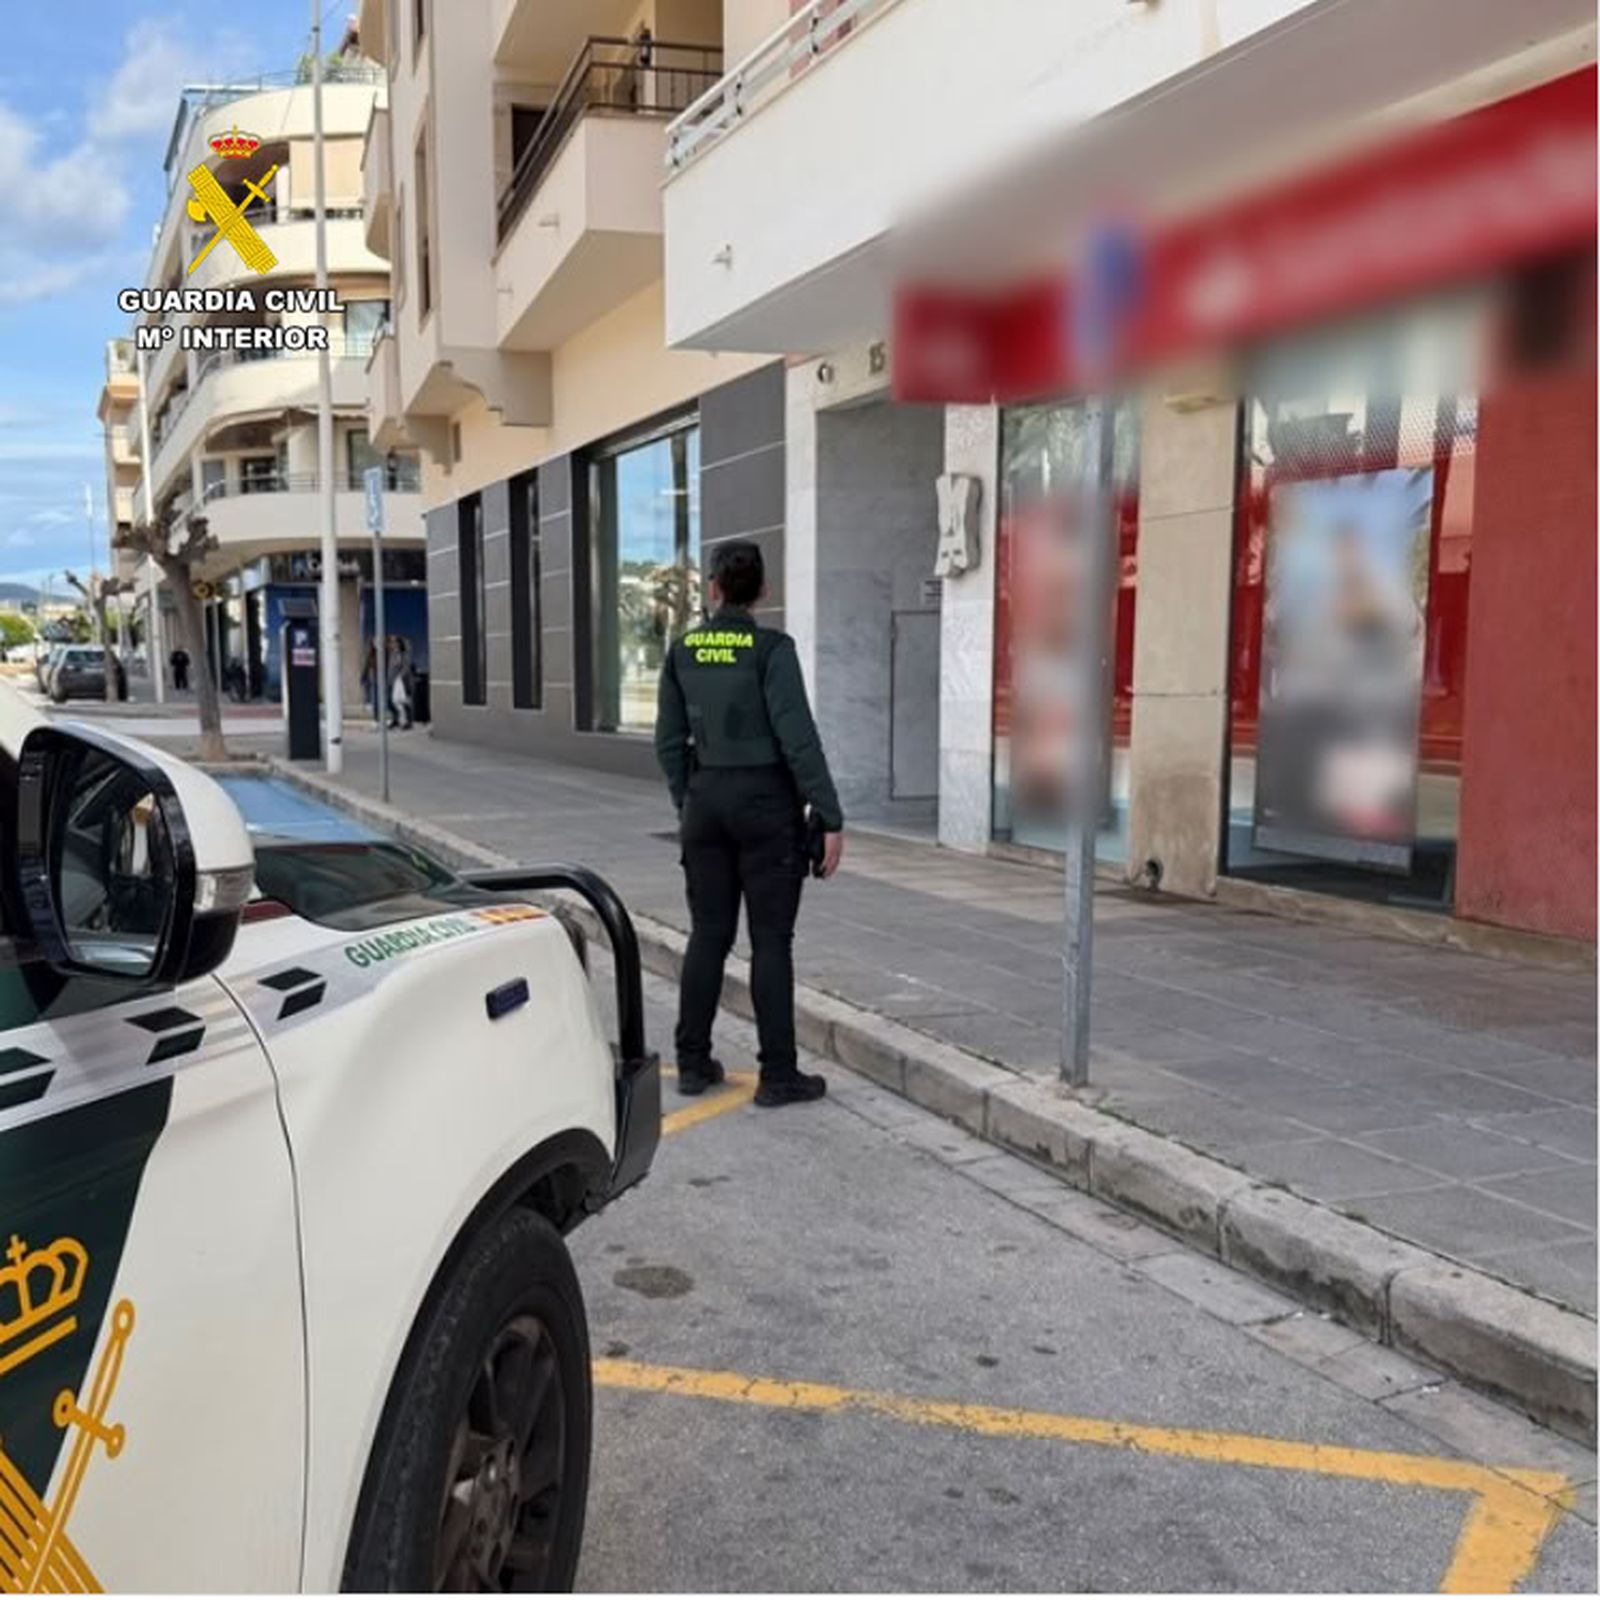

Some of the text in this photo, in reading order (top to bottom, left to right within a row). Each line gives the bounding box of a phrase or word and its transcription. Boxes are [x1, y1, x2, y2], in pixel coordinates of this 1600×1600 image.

[684, 632, 753, 647] GUARDIA
[696, 647, 737, 663] CIVIL
[344, 917, 477, 968] GUARDIA CIVIL
